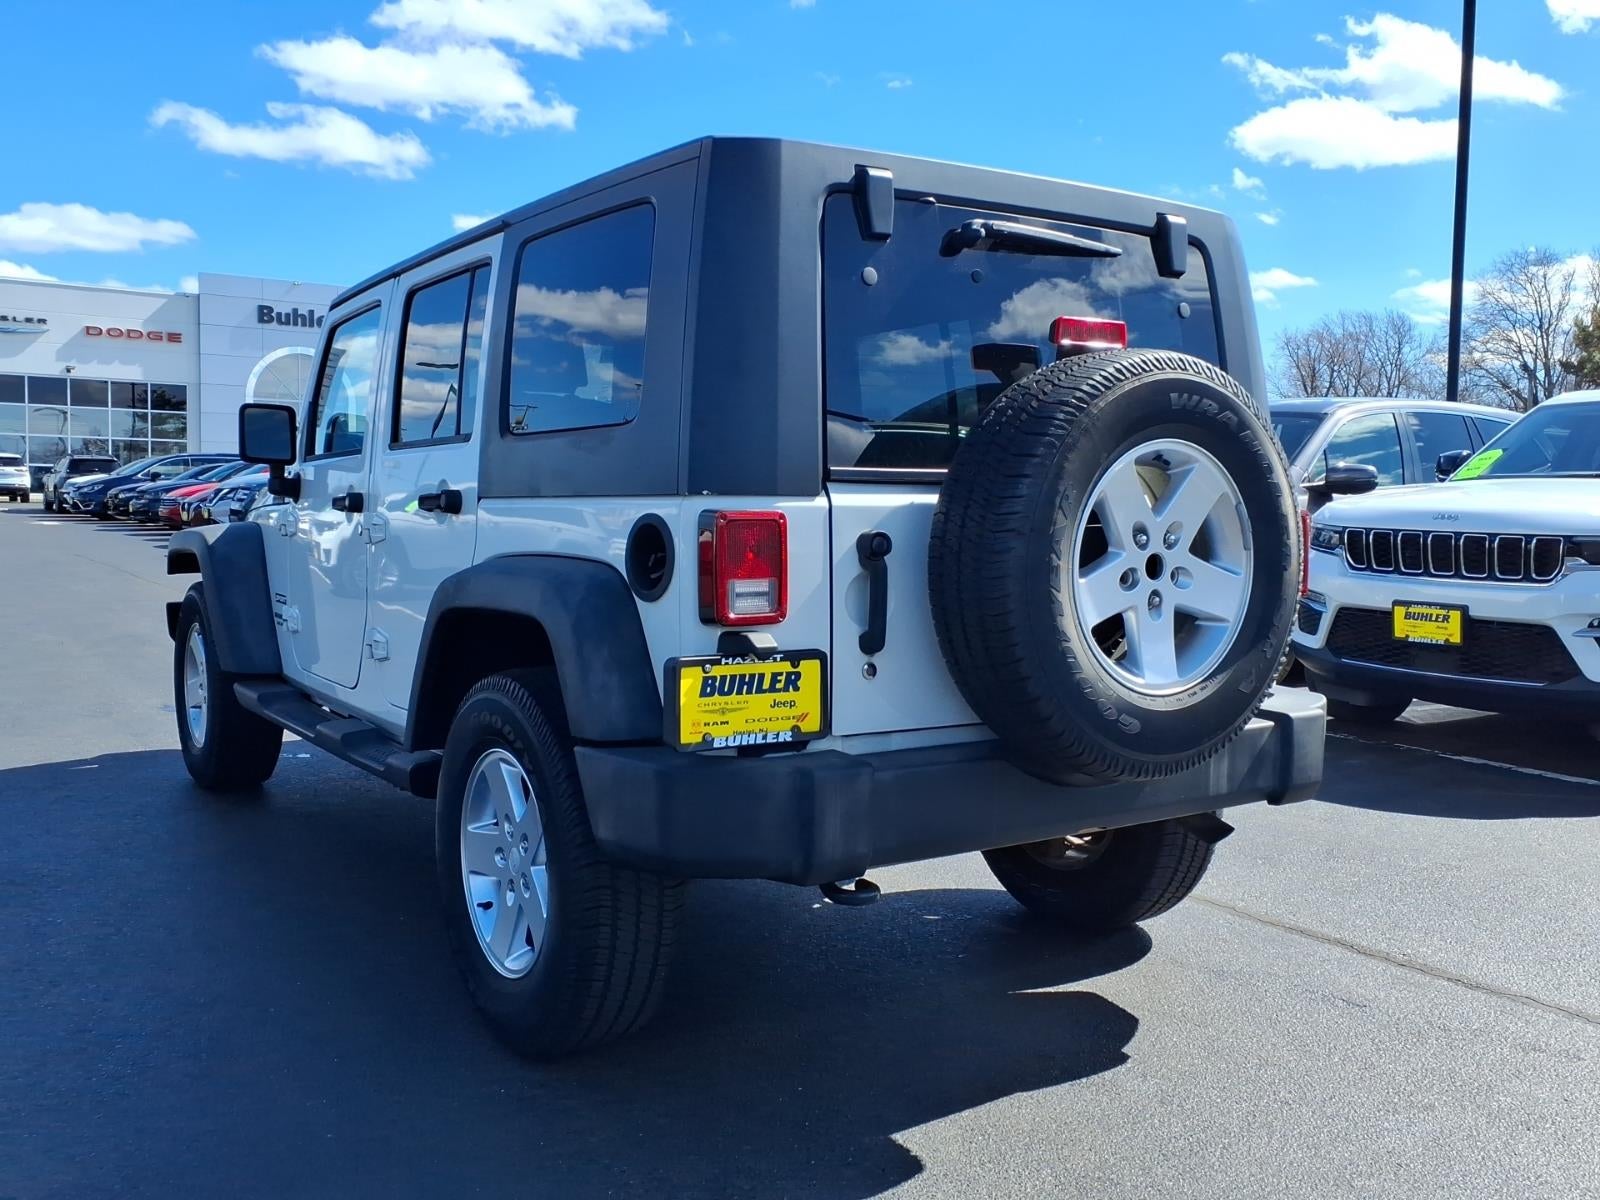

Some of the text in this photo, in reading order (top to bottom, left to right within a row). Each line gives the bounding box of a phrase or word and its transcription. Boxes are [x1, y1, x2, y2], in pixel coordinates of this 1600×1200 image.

[84, 325, 183, 343] DODGE
[1404, 611, 1451, 624] BUHLER
[699, 671, 802, 698] BUHLER
[697, 700, 749, 708] CHRYSLER
[770, 698, 797, 709] Jeep
[745, 714, 801, 724] DODGE
[713, 730, 793, 748] BUHLER
